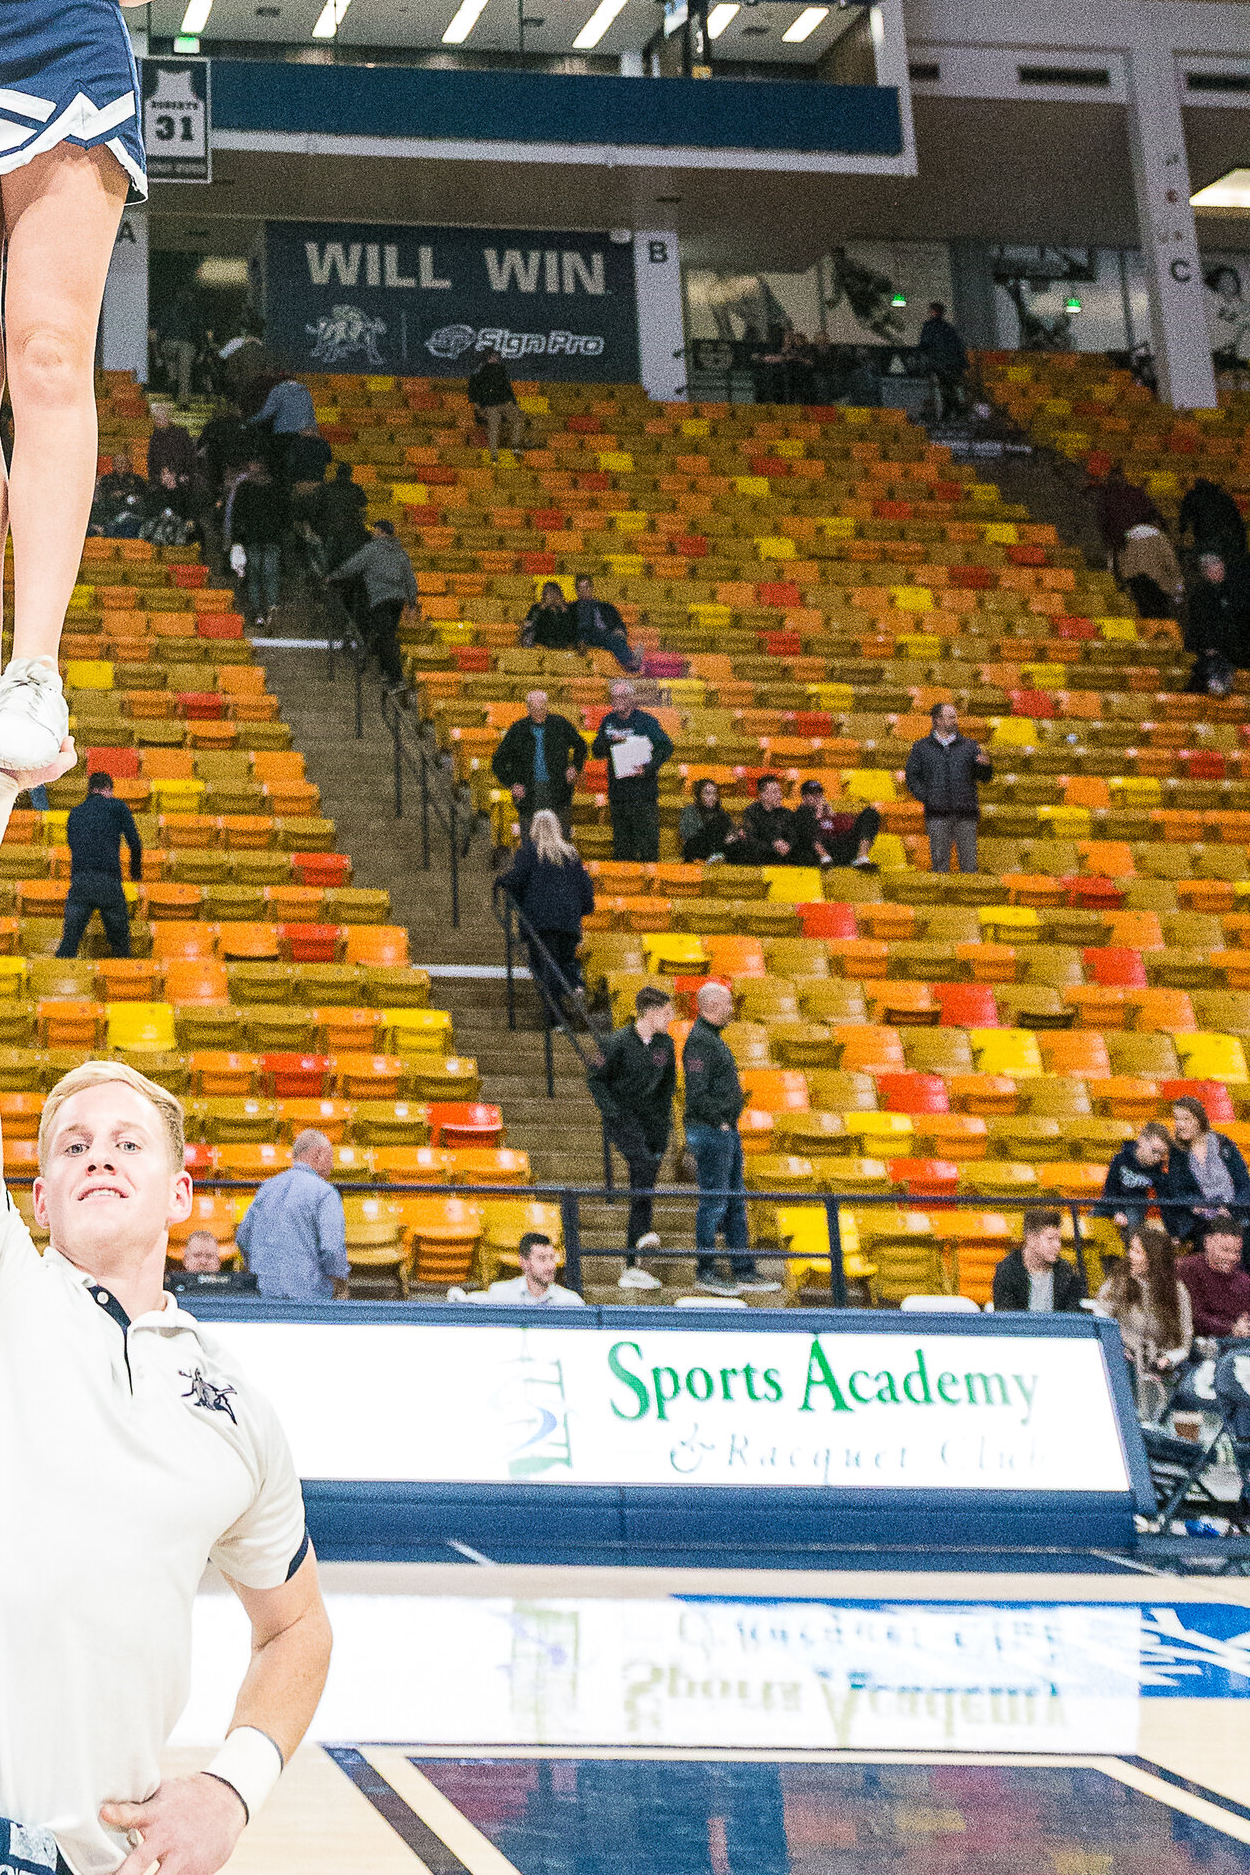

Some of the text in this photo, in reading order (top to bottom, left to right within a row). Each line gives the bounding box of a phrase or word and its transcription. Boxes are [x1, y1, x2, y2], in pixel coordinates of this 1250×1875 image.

[155, 115, 194, 141] 31
[116, 221, 137, 243] A
[649, 241, 668, 264] B
[305, 240, 605, 295] WILL WIN
[1170, 258, 1191, 283] C
[547, 330, 606, 356] Pro
[606, 1333, 1040, 1425] Sports Academy
